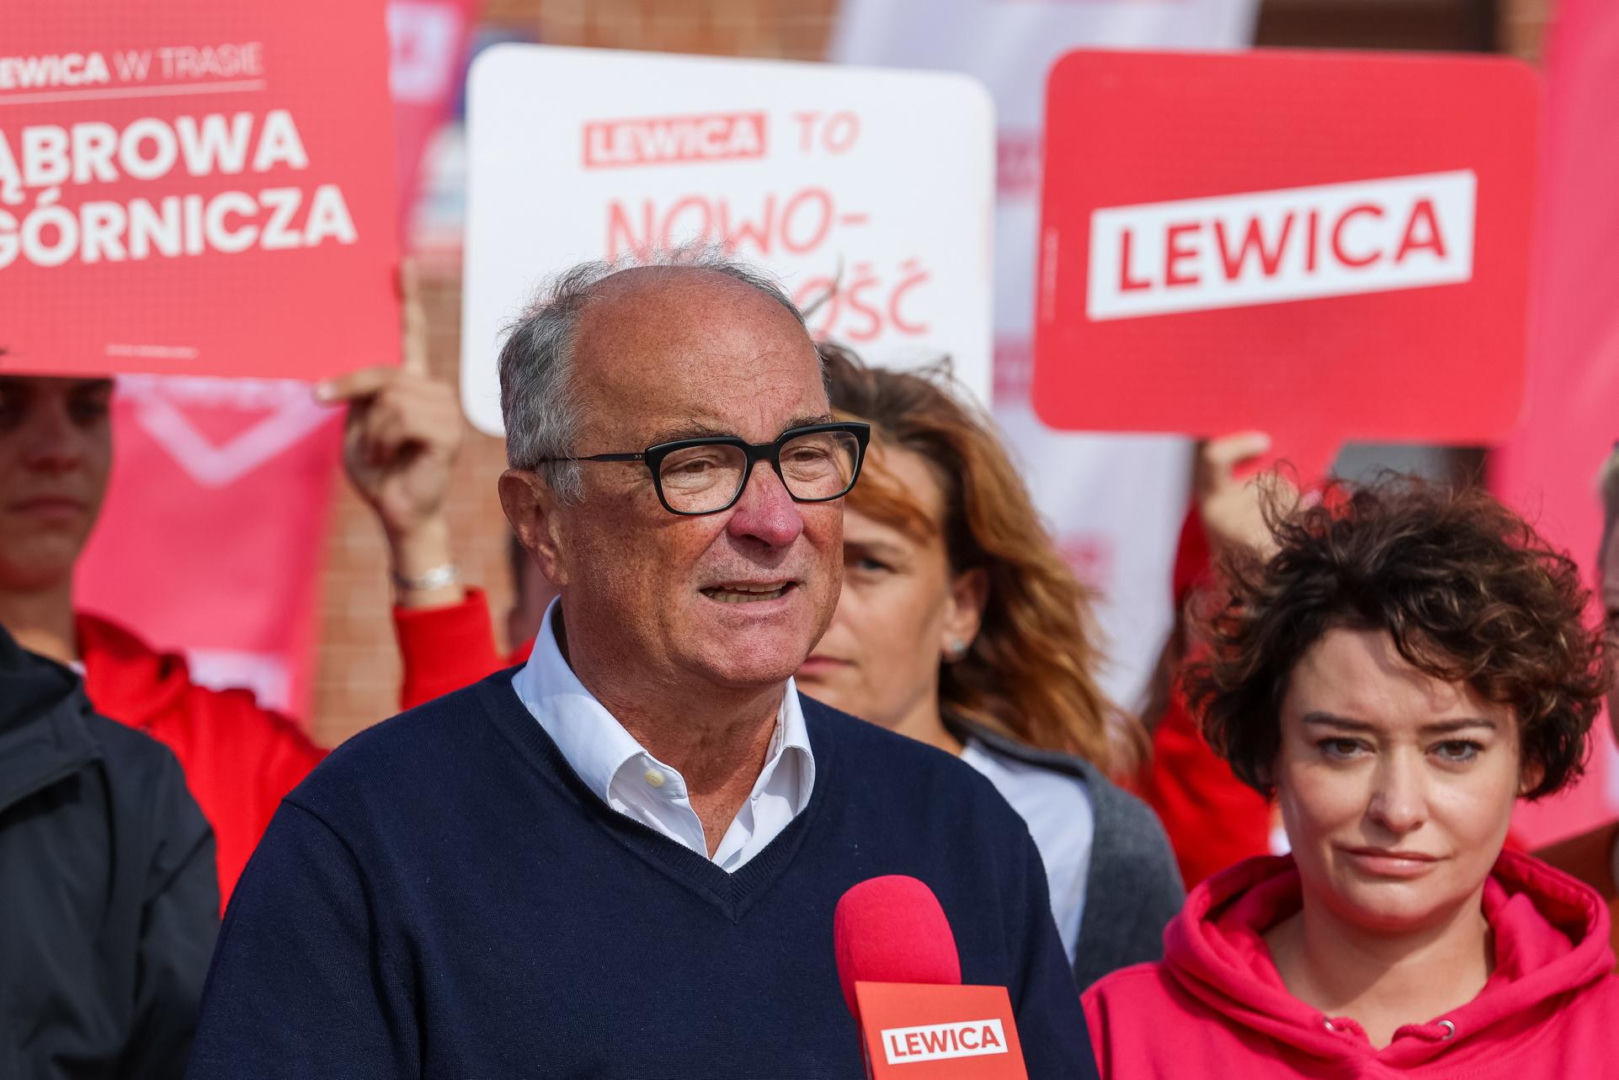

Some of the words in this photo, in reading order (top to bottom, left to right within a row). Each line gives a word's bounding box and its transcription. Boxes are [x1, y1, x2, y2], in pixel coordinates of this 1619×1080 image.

[114, 51, 152, 80] W
[156, 42, 263, 77] TRASIE
[592, 118, 761, 159] LEWICA
[793, 111, 861, 155] TO
[1118, 198, 1447, 292] LEWICA
[890, 1026, 1000, 1057] LEWICA
